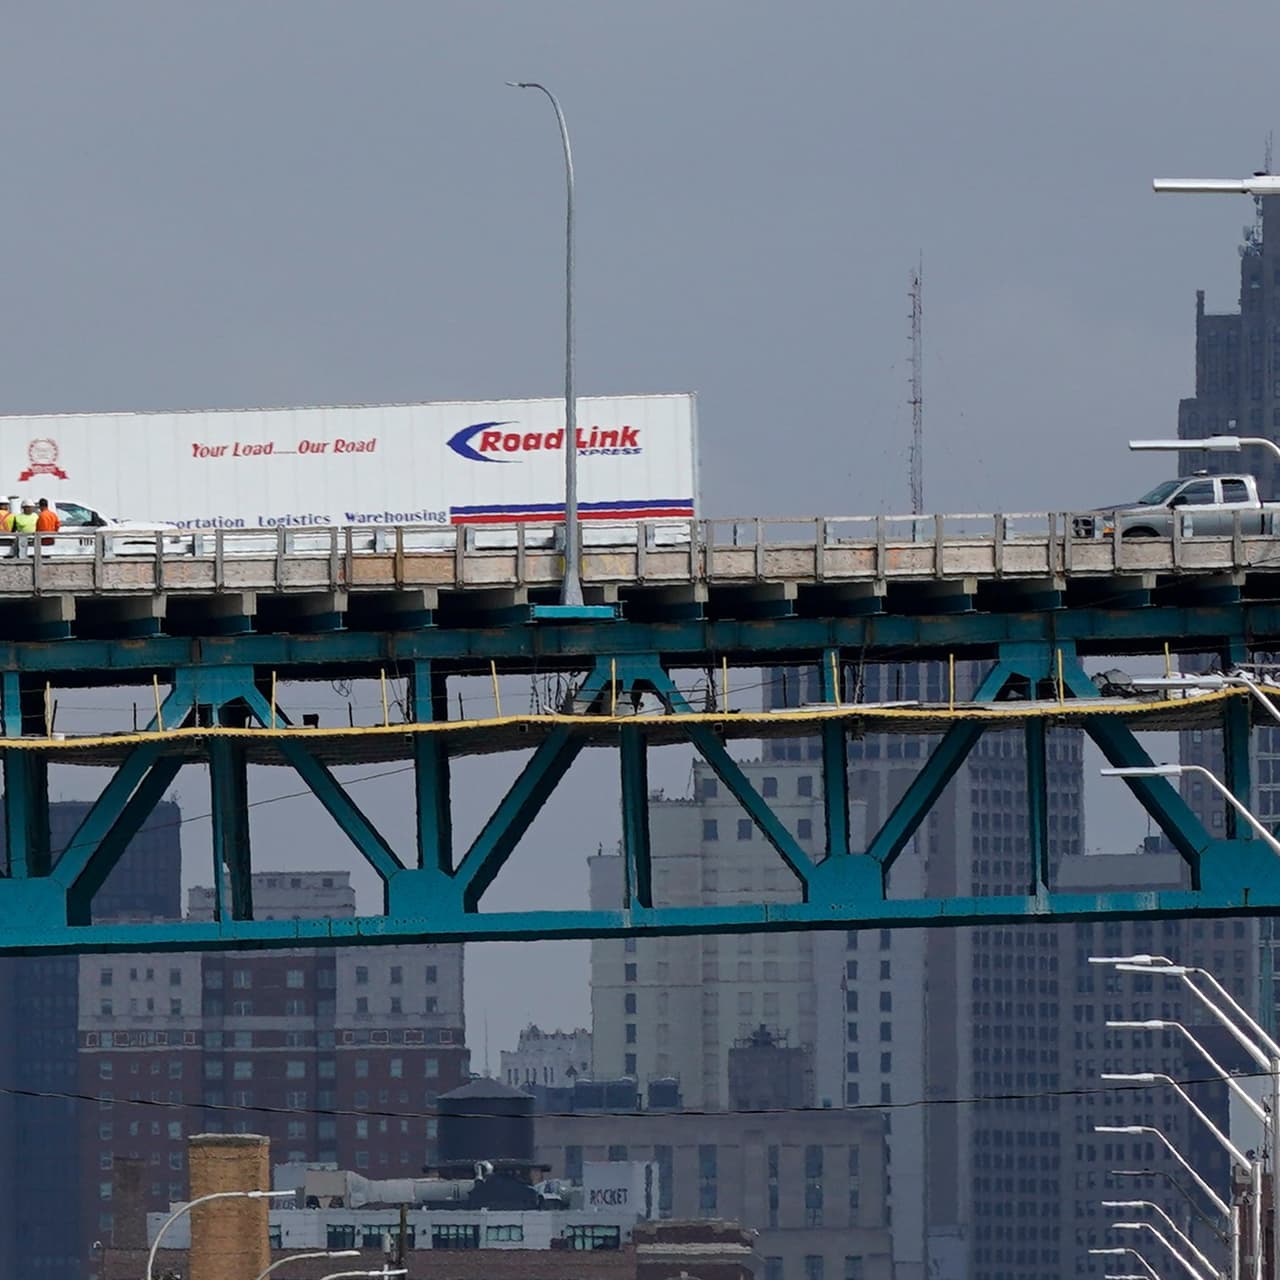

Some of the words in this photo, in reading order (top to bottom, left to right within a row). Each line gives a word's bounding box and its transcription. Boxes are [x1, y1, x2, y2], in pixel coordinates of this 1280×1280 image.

[192, 443, 229, 458] Your
[333, 437, 377, 454] Road
[258, 513, 331, 528] Logistics
[344, 509, 447, 524] Warehousing
[589, 1188, 628, 1206] ROCKET
